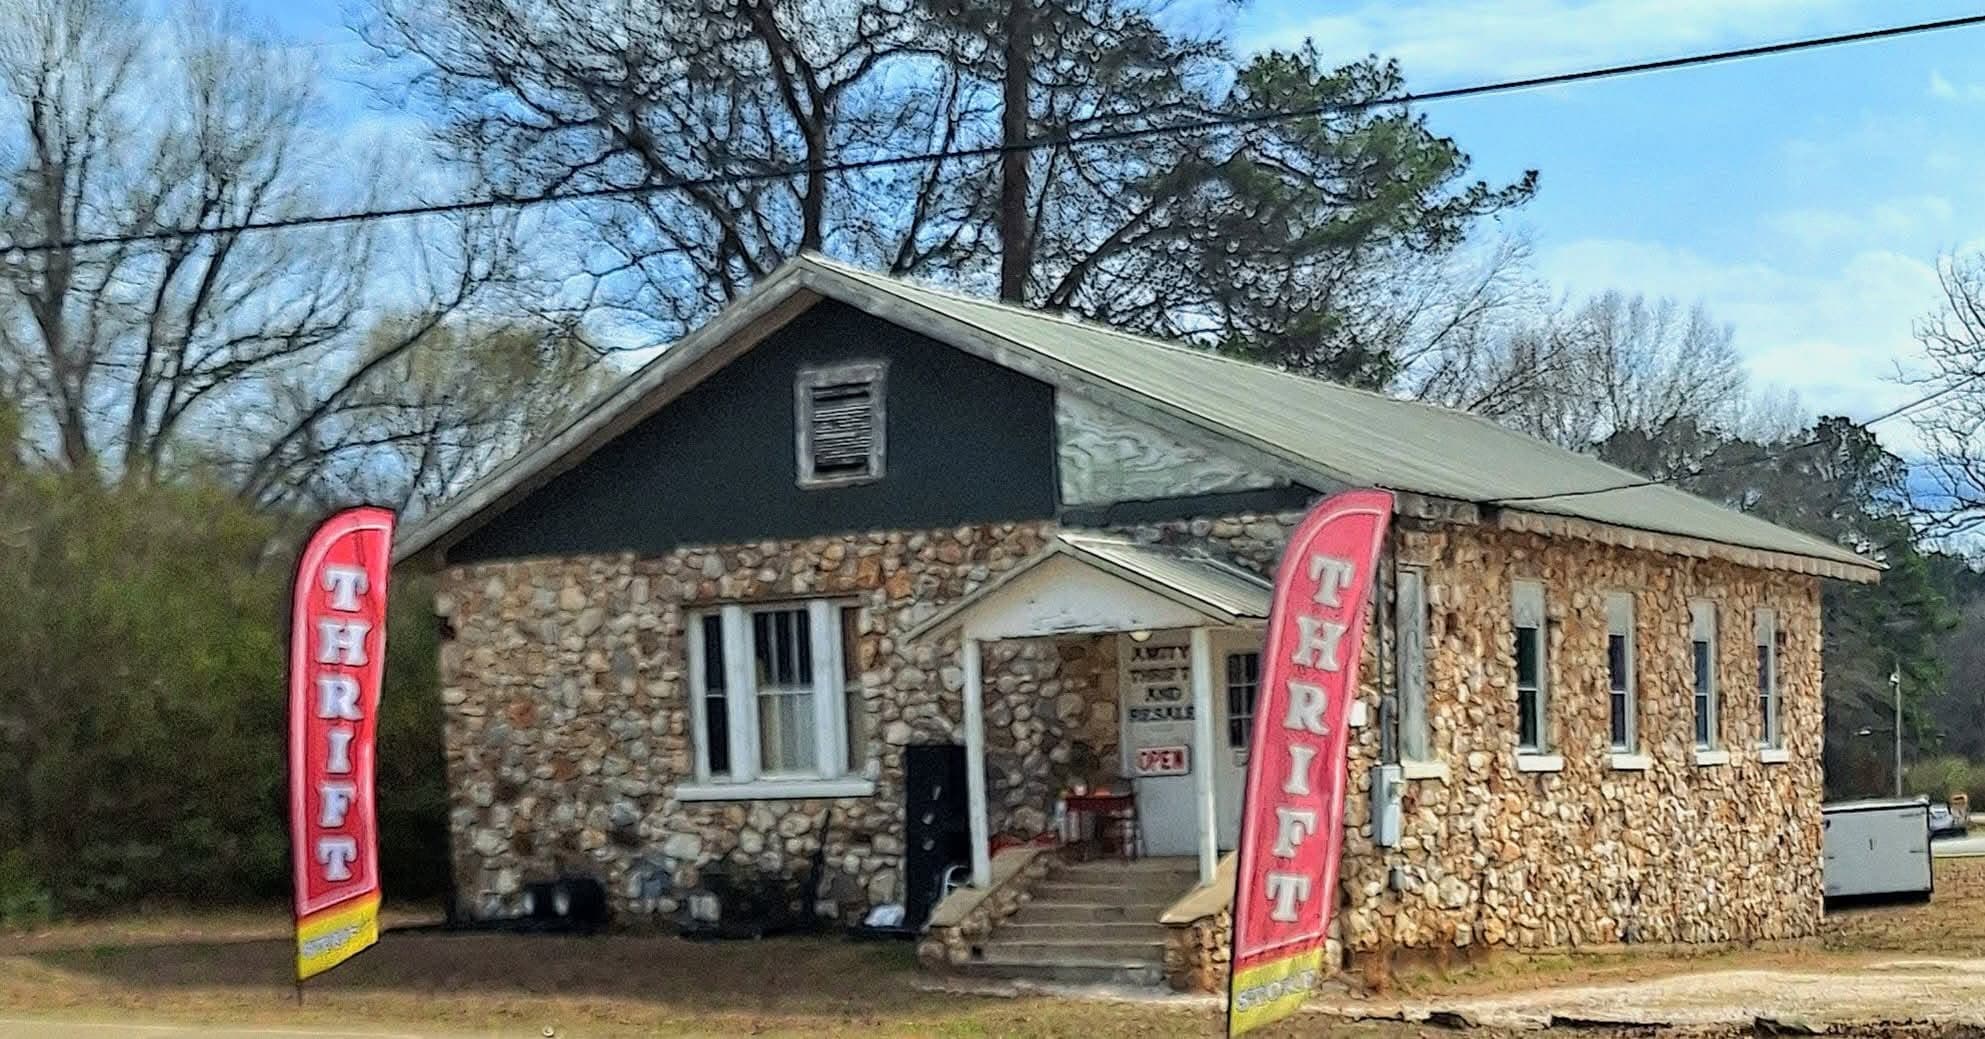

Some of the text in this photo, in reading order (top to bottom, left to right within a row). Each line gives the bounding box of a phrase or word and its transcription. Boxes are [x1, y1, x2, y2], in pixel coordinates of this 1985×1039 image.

[314, 563, 370, 883] THRIFT
[1137, 750, 1185, 770] OPEN
[1144, 686, 1182, 702] AND
[1265, 554, 1354, 923] THRIFT
